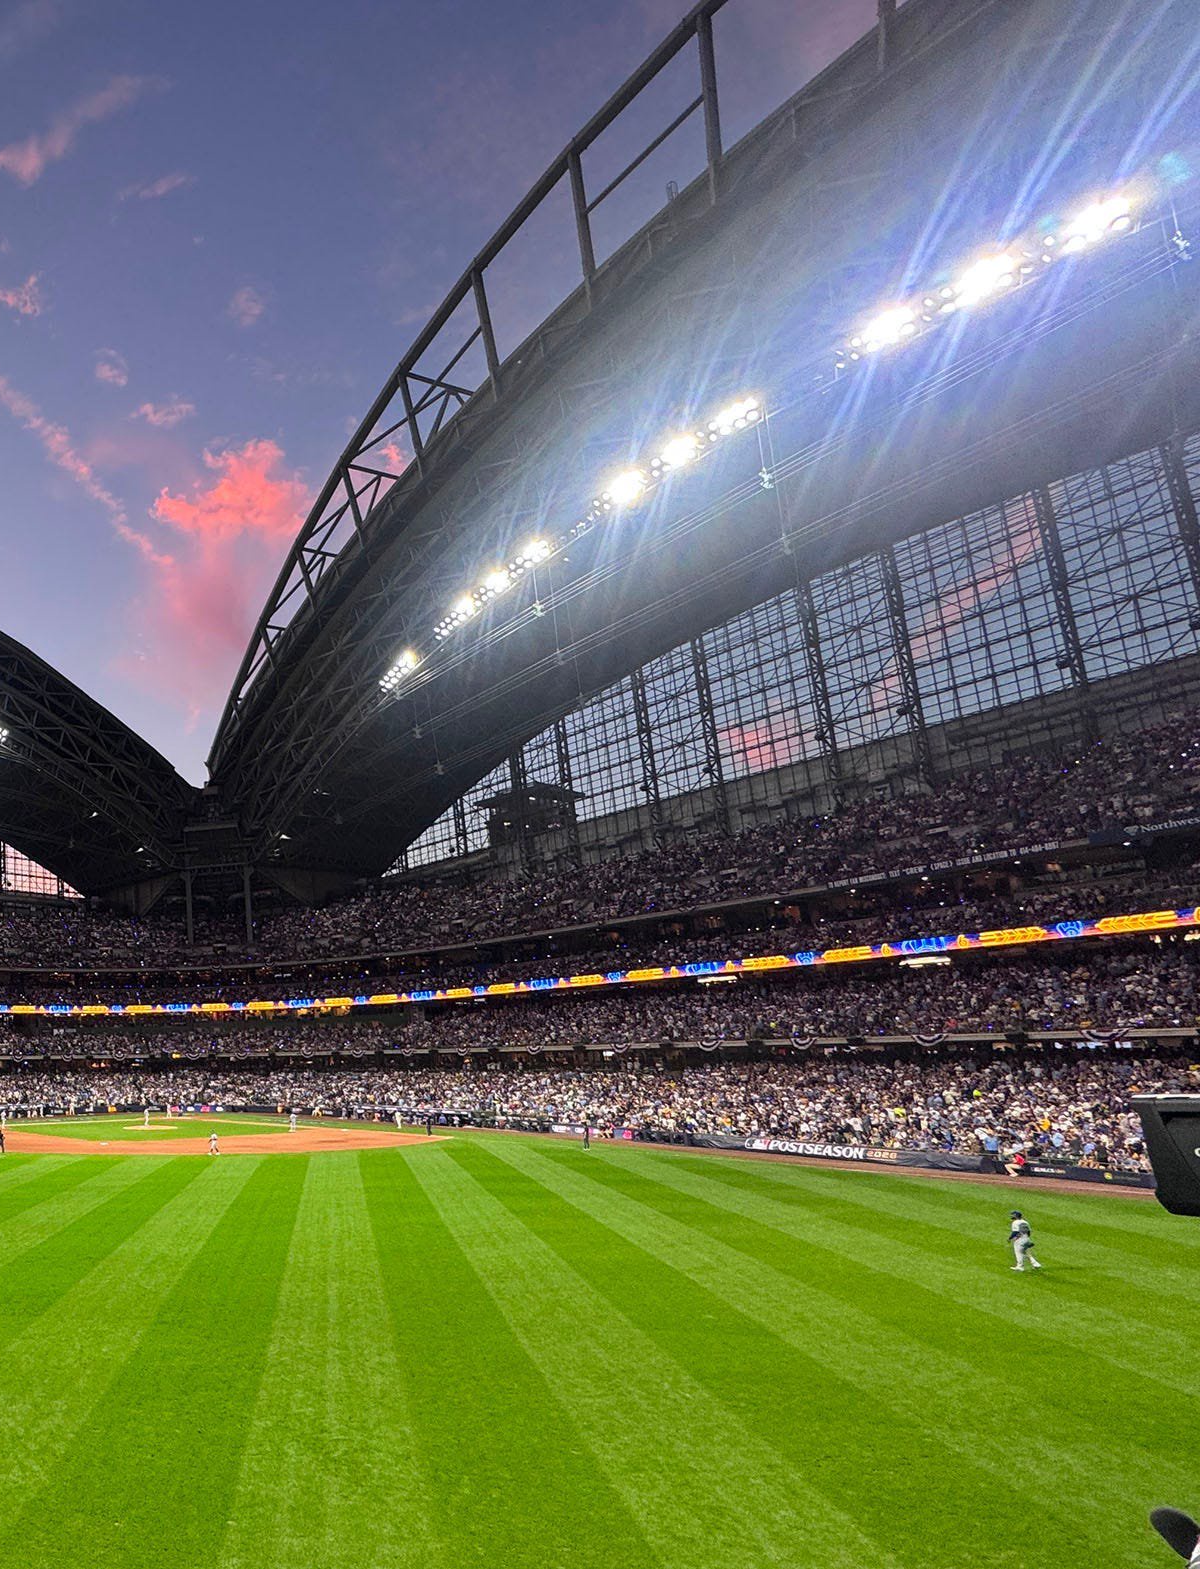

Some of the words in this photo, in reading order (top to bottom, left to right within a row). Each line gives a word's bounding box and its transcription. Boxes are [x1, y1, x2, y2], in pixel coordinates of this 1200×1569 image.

[957, 934, 968, 949] 6
[881, 943, 891, 957] 6
[768, 1139, 865, 1159] POSTSEASON
